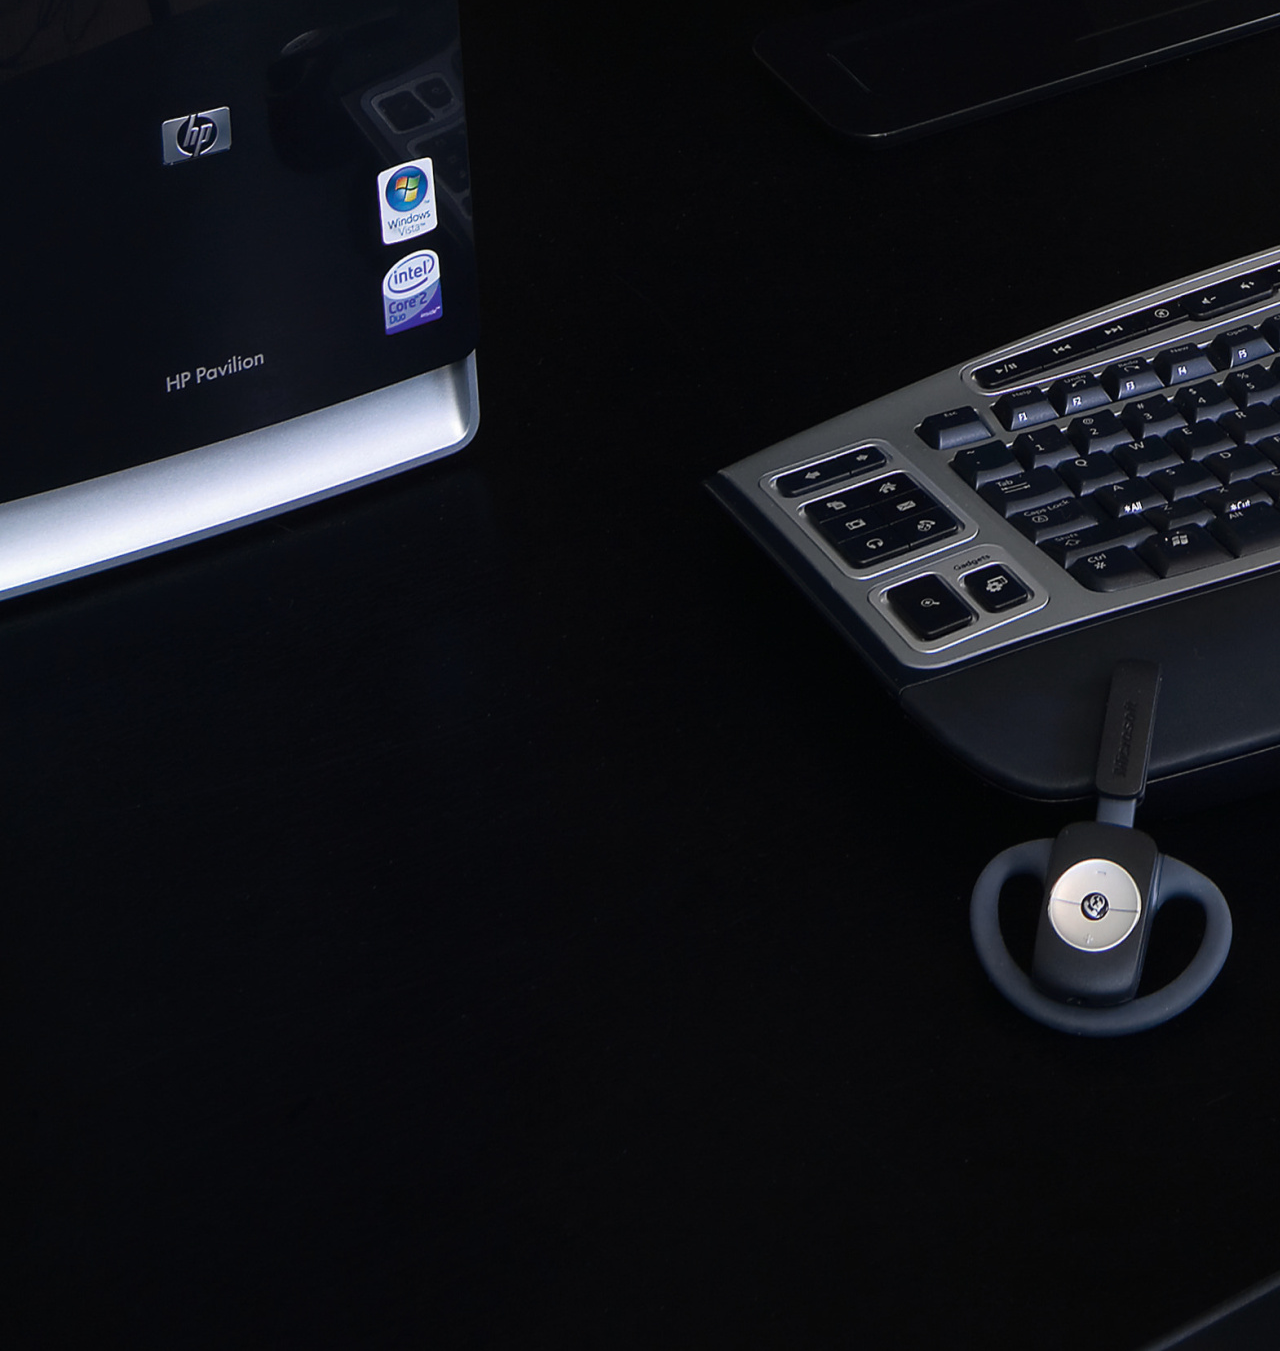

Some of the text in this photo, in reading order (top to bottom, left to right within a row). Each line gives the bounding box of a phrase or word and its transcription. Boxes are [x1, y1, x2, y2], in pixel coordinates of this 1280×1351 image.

[387, 210, 431, 230] Windows
[393, 261, 429, 285] intel
[388, 299, 416, 315] Core
[389, 312, 406, 325] Duo
[1238, 349, 1247, 359] F5
[166, 353, 265, 393] HP Pavilion
[1178, 366, 1187, 375] F4
[1125, 382, 1135, 391] F3
[1072, 396, 1082, 406] F2
[1018, 412, 1028, 422] F1
[1235, 411, 1247, 419] R
[1182, 428, 1192, 436] E
[1128, 441, 1145, 450] W
[1075, 459, 1088, 467] Q
[953, 553, 991, 572] Gadgets
[1087, 553, 1107, 564] Ctrl
